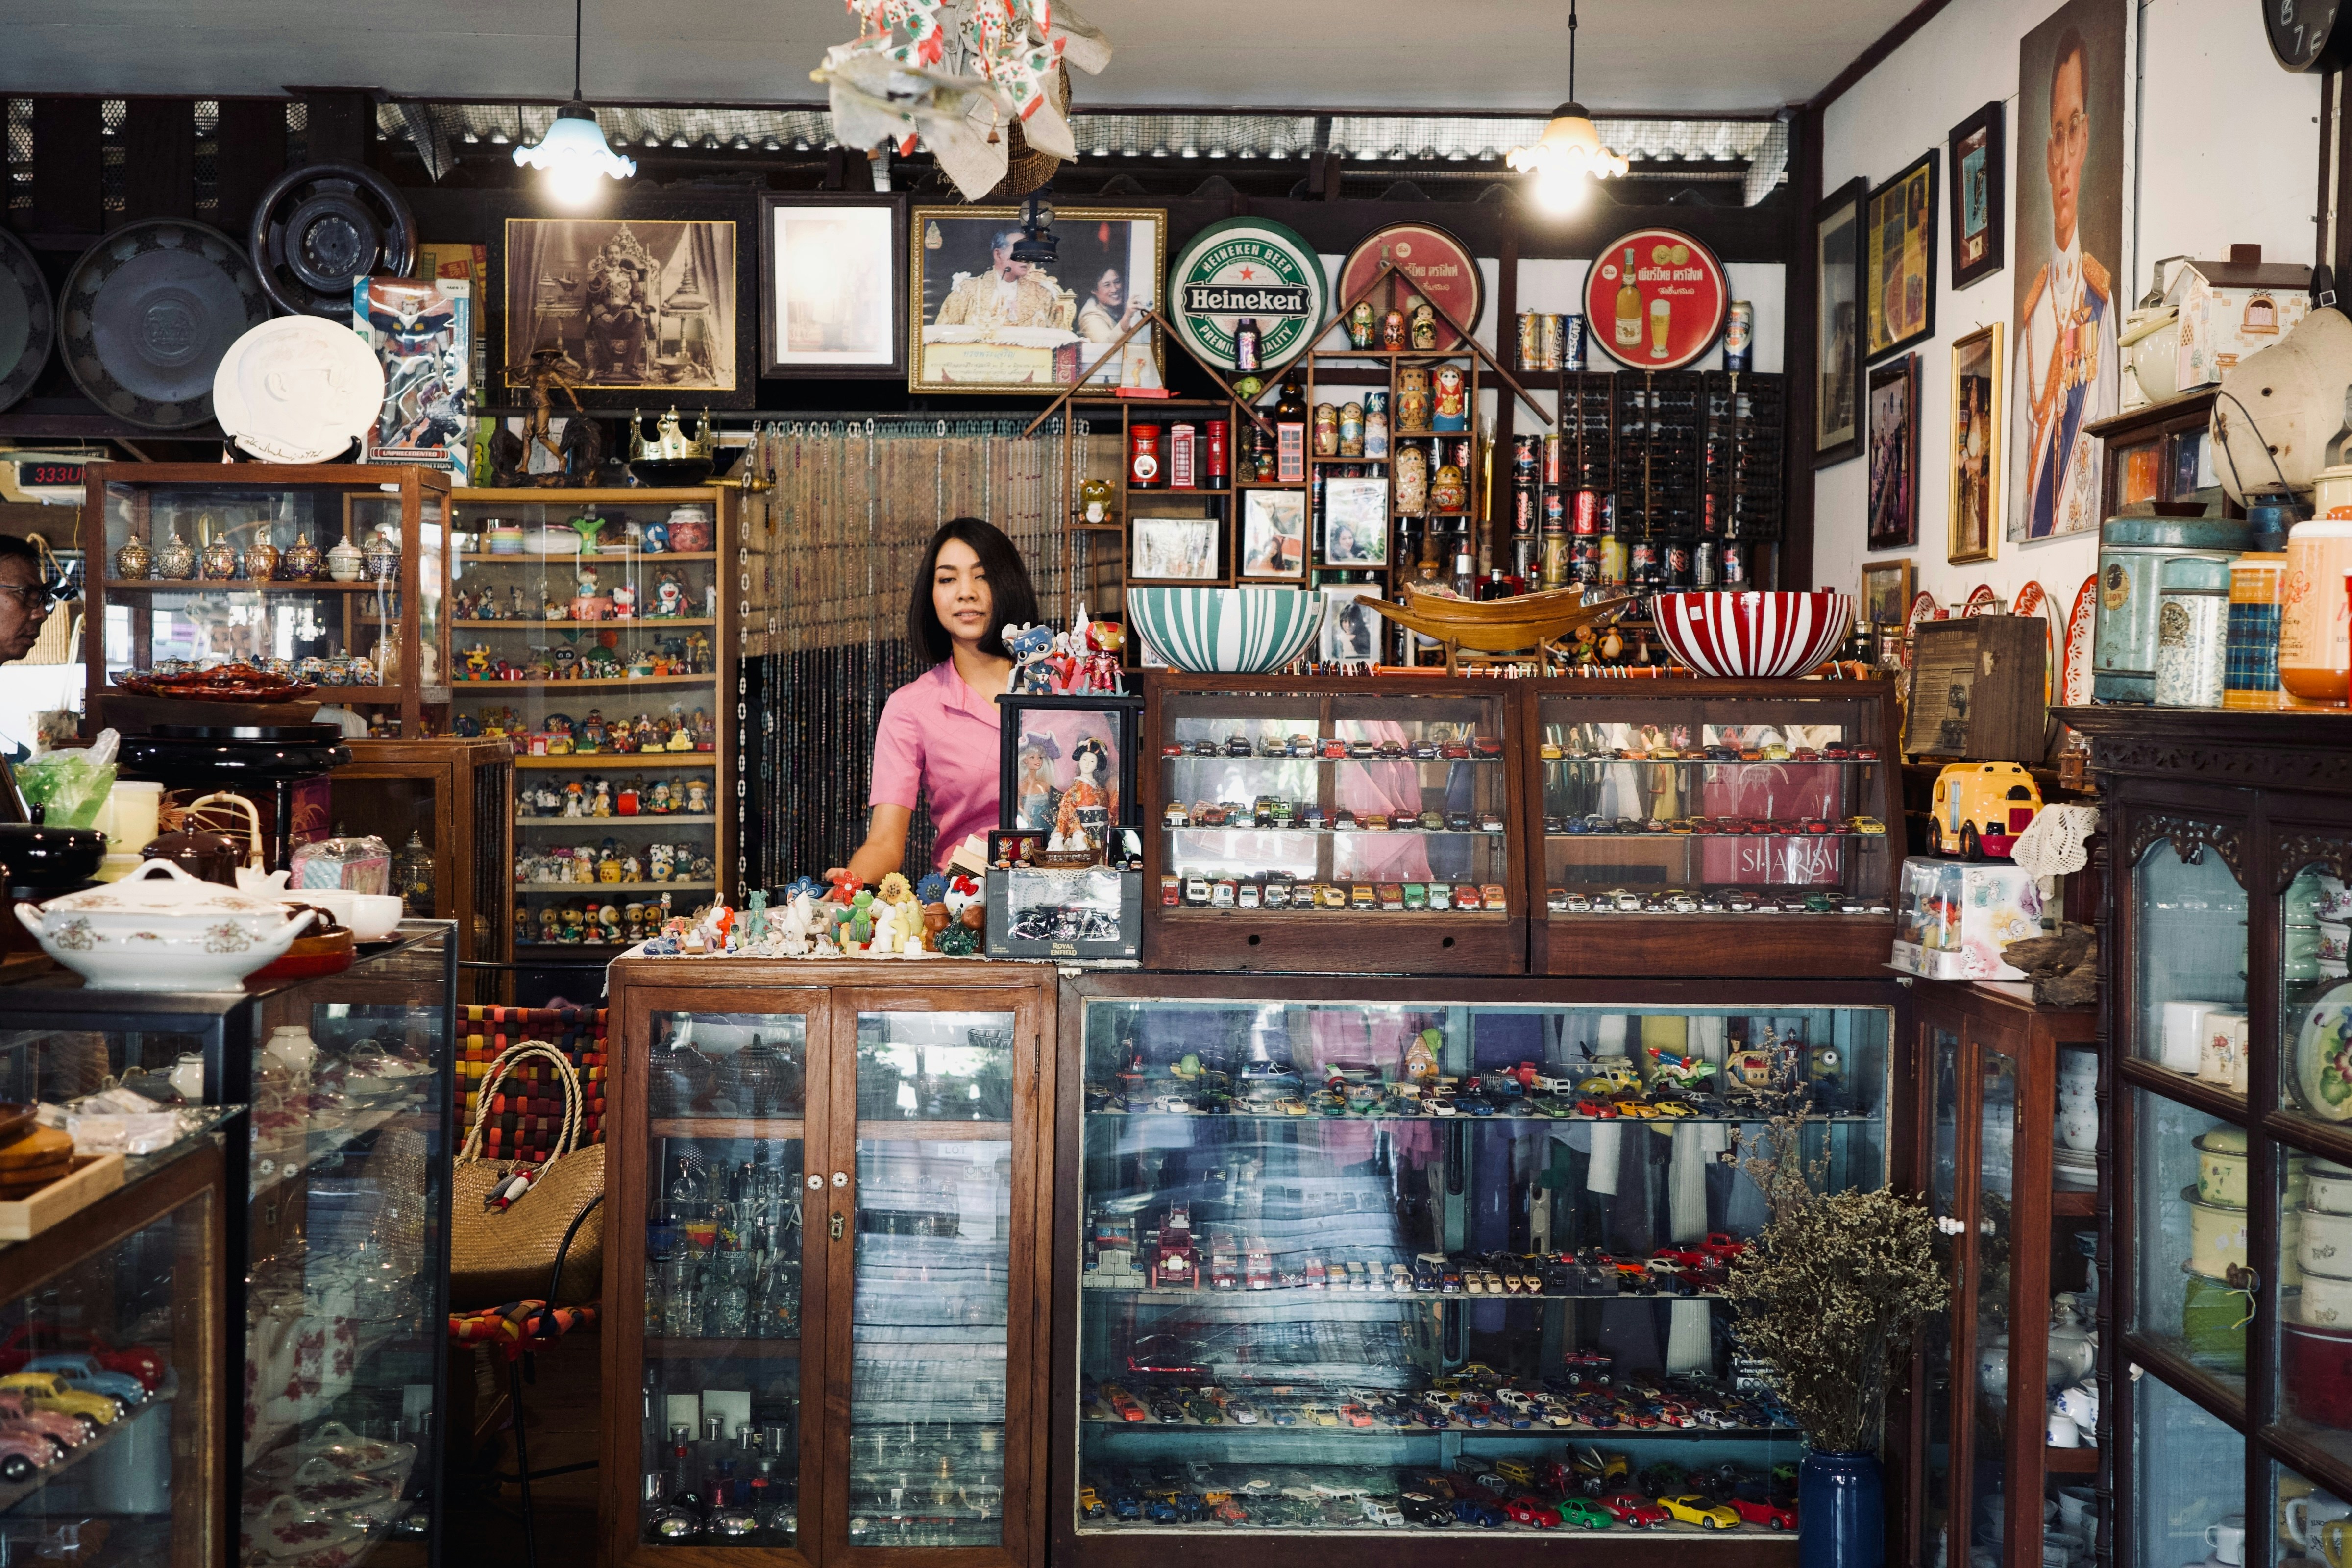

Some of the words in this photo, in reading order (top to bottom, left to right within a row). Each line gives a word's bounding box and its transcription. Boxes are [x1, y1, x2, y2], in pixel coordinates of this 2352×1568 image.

[1201, 244, 1260, 273] HEINEKEN
[1264, 249, 1293, 274] BEER
[1191, 289, 1302, 310] Heineken
[1199, 324, 1235, 355] PREMIU
[1261, 326, 1294, 355] UALITY
[34, 467, 87, 483] 333U
[945, 1146, 967, 1154] LOT
